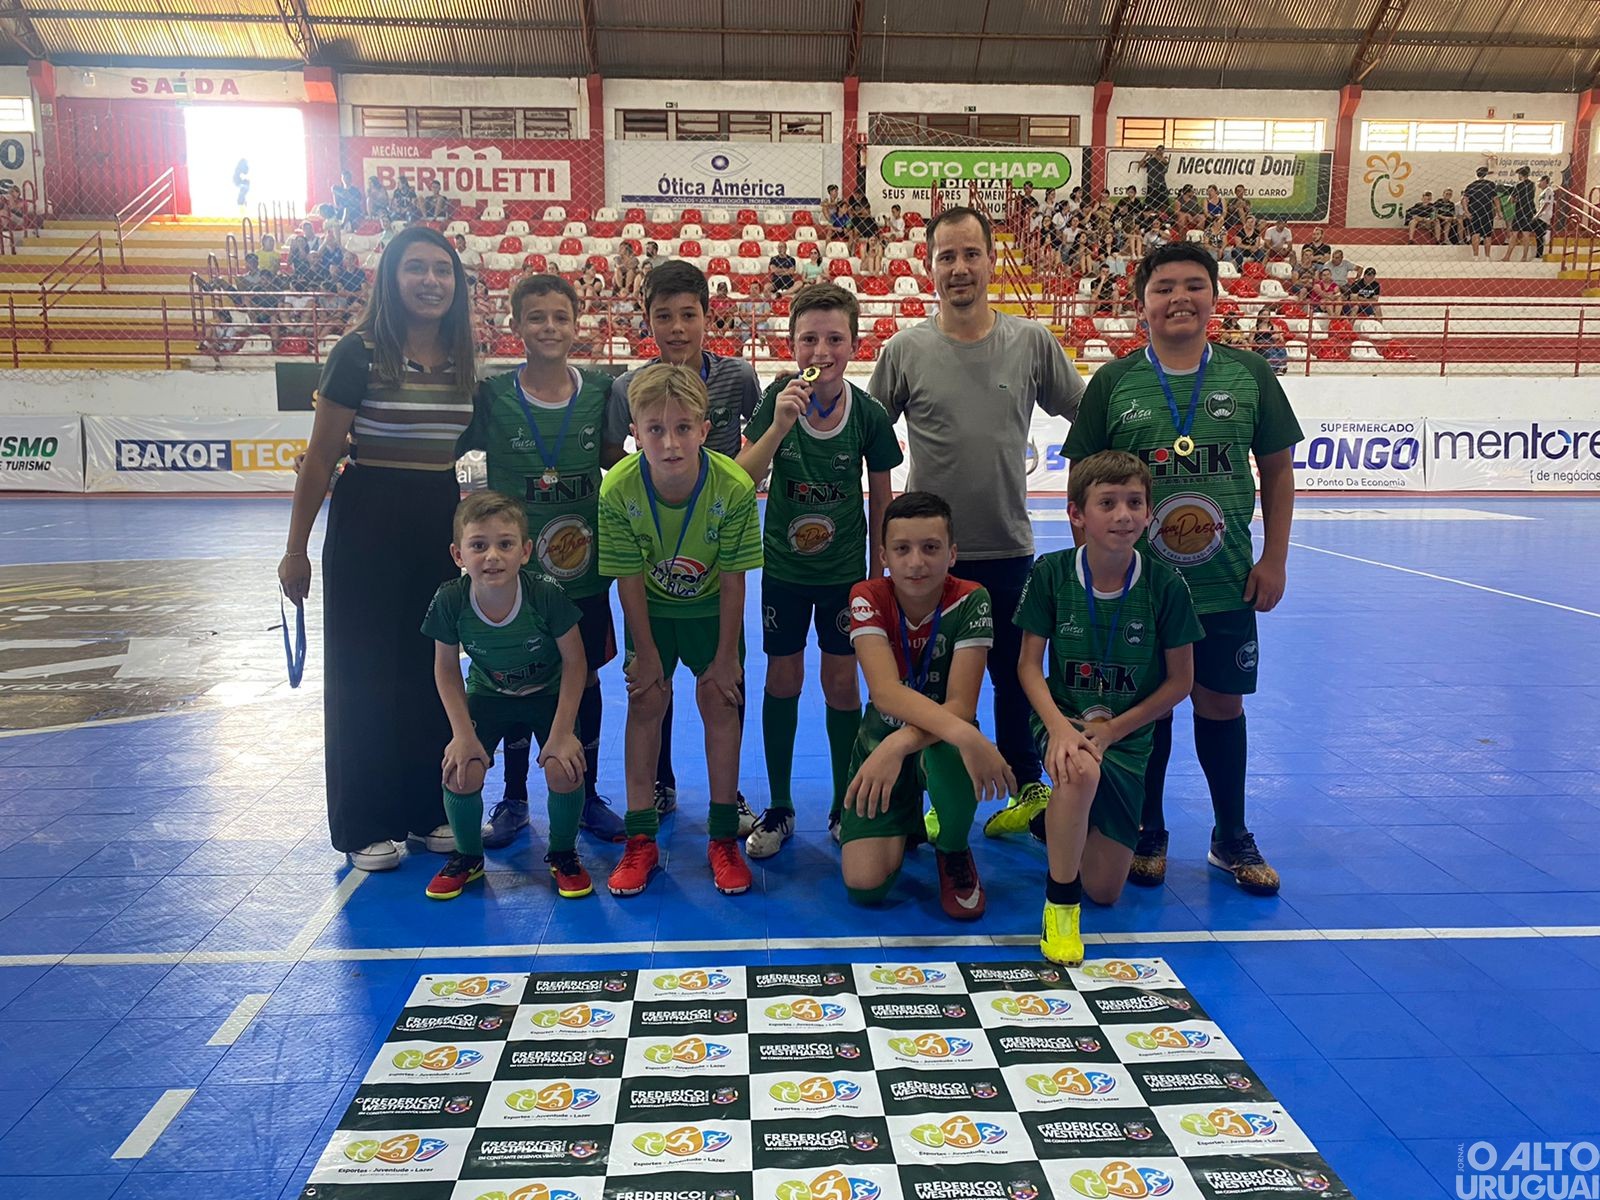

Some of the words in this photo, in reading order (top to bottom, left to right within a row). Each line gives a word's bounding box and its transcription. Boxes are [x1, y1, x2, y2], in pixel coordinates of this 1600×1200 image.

[130, 71, 239, 95] SADA
[1530, 158, 1562, 168] completa
[894, 161, 963, 178] FOTO
[973, 162, 1060, 179] CHAPA
[376, 166, 555, 192] BERTOLETTI
[658, 173, 705, 196] Ótica
[711, 178, 785, 197] América
[882, 189, 905, 199] SEUS
[912, 189, 961, 200] MELORES
[969, 190, 1024, 200] OMENOS
[1258, 188, 1288, 197] CARRO
[1320, 423, 1414, 433] SUPERMERCADO
[120, 443, 226, 468] BAKOF
[1292, 437, 1420, 470] LONGO
[6, 460, 52, 471] TURISMO
[1306, 478, 1315, 487] O
[1317, 478, 1344, 487] Ponto
[1346, 478, 1359, 487] Da
[1361, 478, 1406, 487] Economia
[1536, 470, 1550, 481] de
[1552, 470, 1600, 485] negócios
[1142, 1073, 1216, 1082] FREDERICO
[890, 1081, 963, 1090] FREDERICO
[1145, 1080, 1221, 1088] WESTPHALEN
[631, 1089, 705, 1098] FREDERICO
[893, 1087, 966, 1096] WESTPHALEN
[364, 1096, 440, 1105] FREDERICO
[631, 1096, 705, 1104] WESTPHALEN
[362, 1102, 441, 1111] WESTPHALEN
[1037, 1122, 1113, 1132] FREDERICO
[764, 1130, 843, 1141] FREDERICO
[1041, 1129, 1118, 1138] WESTPHALEN
[765, 1138, 845, 1147] WESTPHALEN
[480, 1145, 564, 1154] WESTPHALEN
[1203, 1169, 1285, 1183] FREDERICO
[914, 1180, 999, 1192] FREDERICO
[1208, 1179, 1292, 1190] WESTPHALEN
[616, 1190, 702, 1200] FREDERICO
[918, 1189, 1001, 1200] WESTPHALEN
